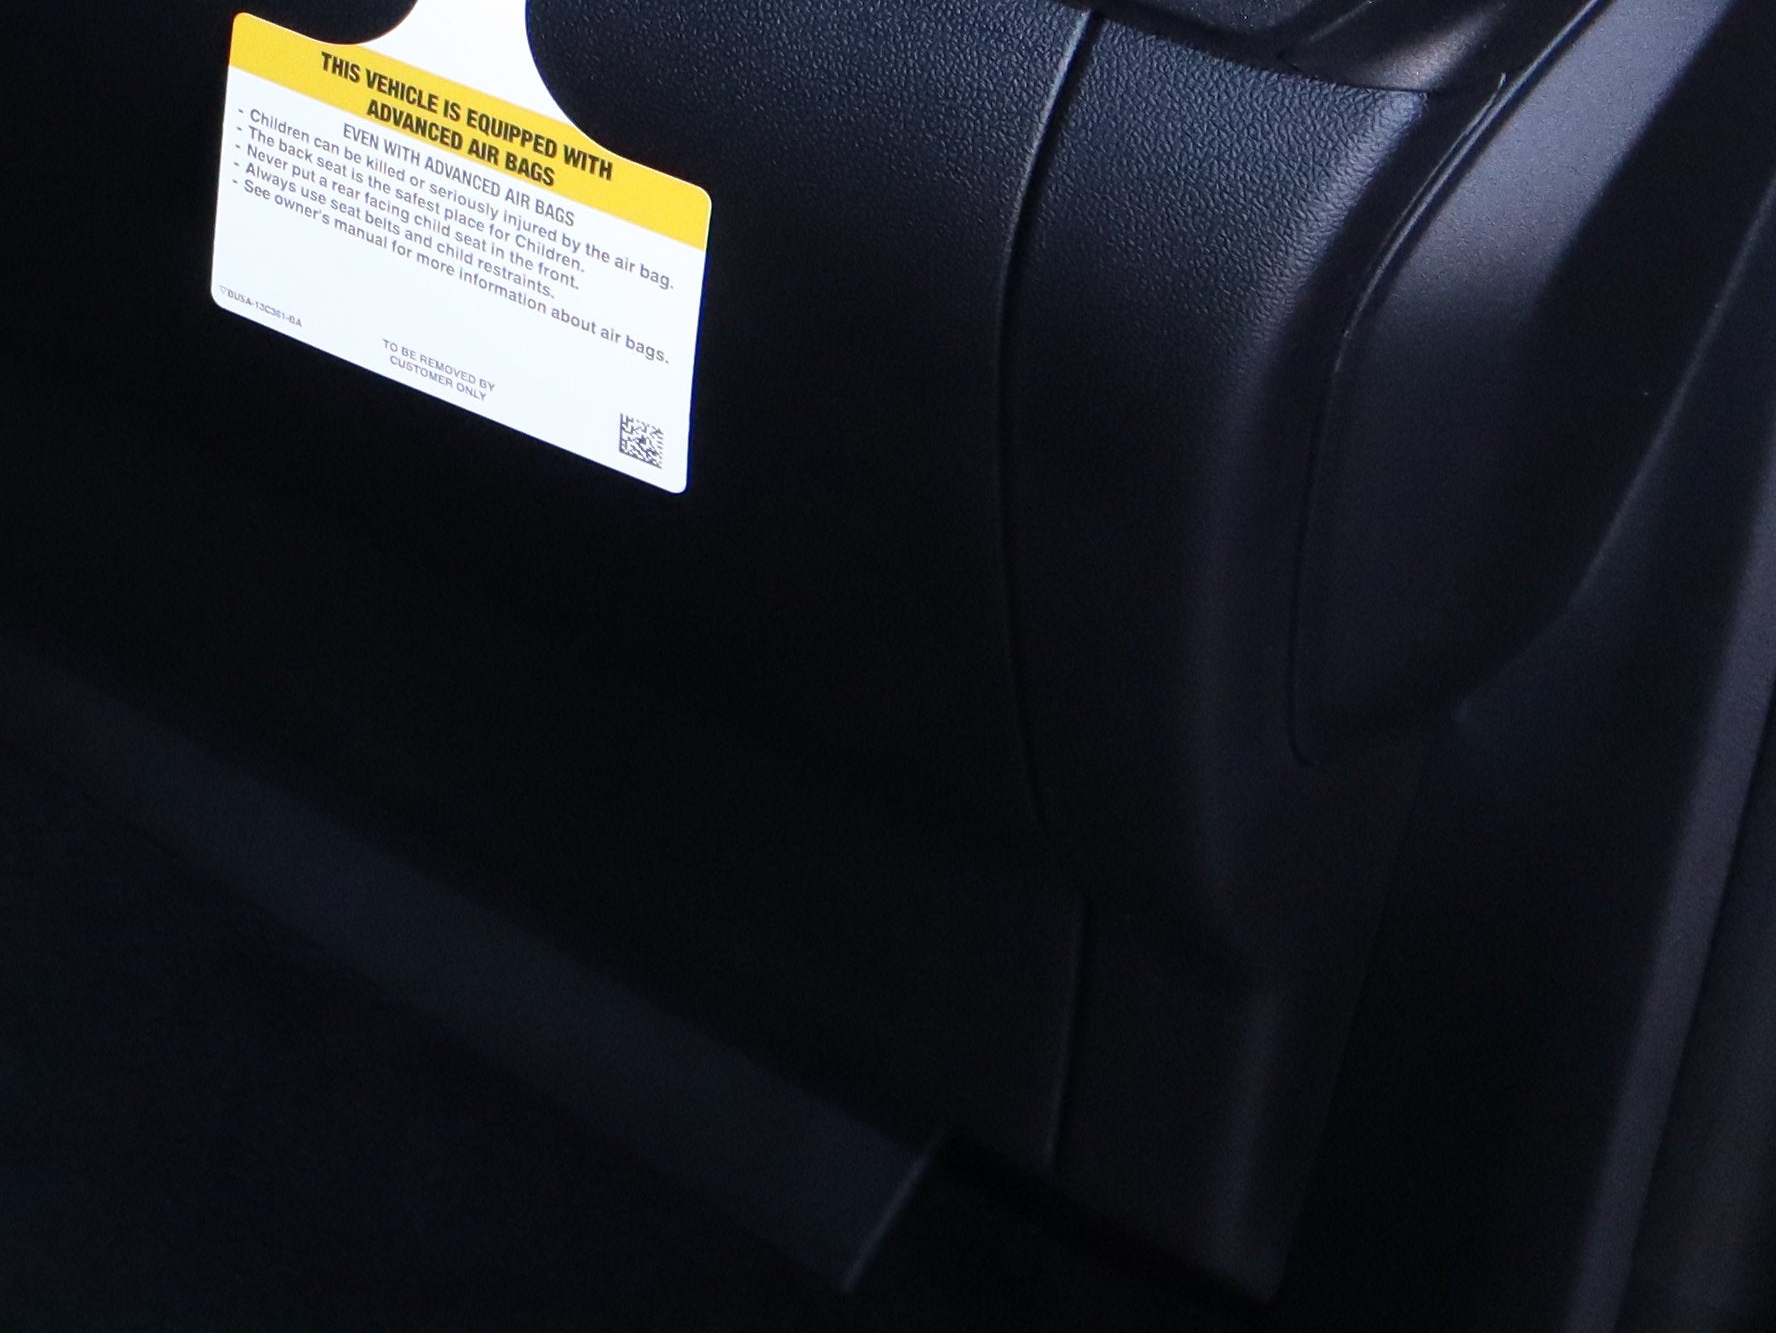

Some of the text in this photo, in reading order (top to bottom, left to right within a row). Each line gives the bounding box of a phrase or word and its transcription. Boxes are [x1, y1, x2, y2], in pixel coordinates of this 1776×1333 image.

[319, 49, 614, 182] THIS VEHICLE IS EQUIPPED WITH
[342, 121, 575, 227] EVEN WITH ADVANCED AIR BAGS
[364, 97, 556, 187] ADVANCED AIR BAGS
[244, 161, 555, 299] Always use seat belts and child restraints.
[246, 142, 579, 290] Never put a rear facing child seat in the front.
[247, 123, 585, 273] The back seat is the safest place for Children.
[248, 107, 674, 291] Children can be killed or seriously injured by the air bag.
[242, 177, 669, 364] See owner's manual for more information about air bags.
[382, 338, 495, 392] TO BE REMOVED BY
[388, 354, 487, 401] CUSTOMER ONLY
